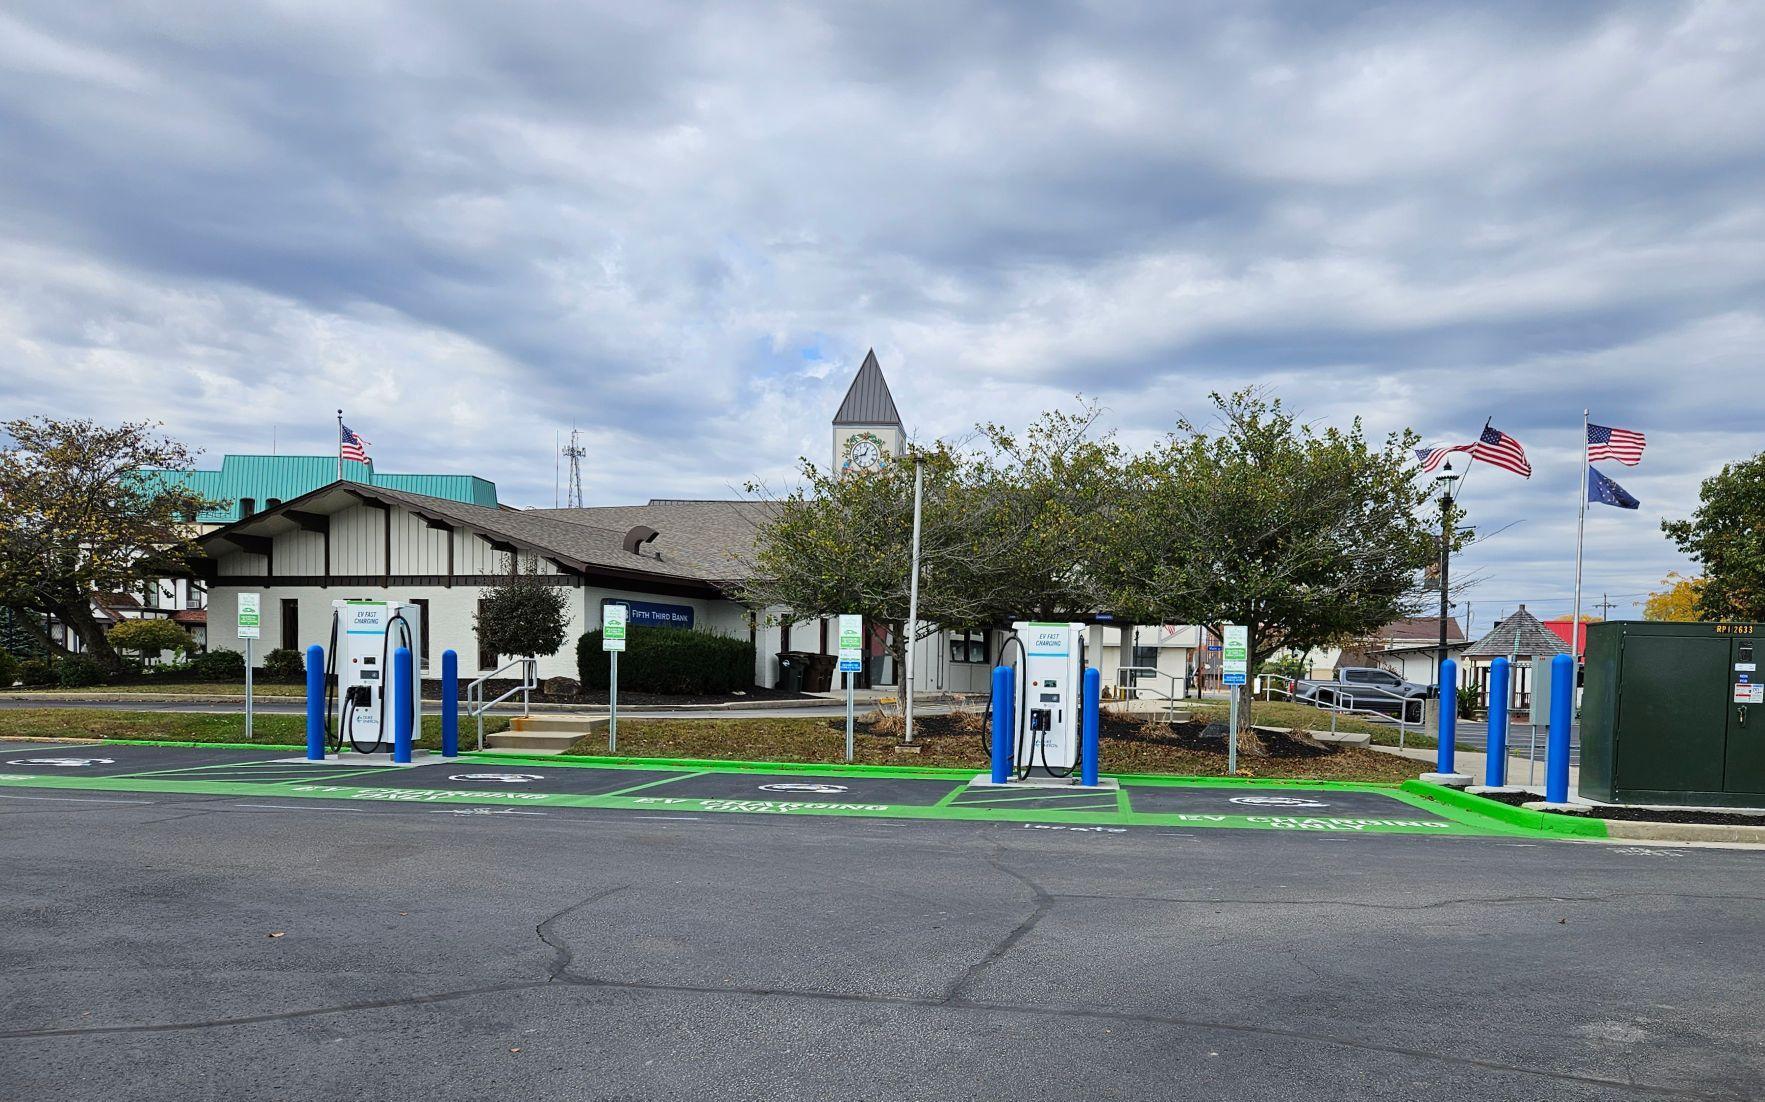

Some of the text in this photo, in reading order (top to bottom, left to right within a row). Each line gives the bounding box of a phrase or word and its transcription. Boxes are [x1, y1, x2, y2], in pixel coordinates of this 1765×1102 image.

[632, 609, 650, 619] FIFTH
[651, 611, 671, 621] THIRD
[671, 613, 688, 622] BANK
[354, 617, 379, 625] CHARGING
[1733, 625, 1753, 634] 2633
[699, 800, 889, 811] CHARGING
[704, 805, 801, 813] ONLY
[1246, 816, 1450, 828] CHARGING
[1270, 822, 1366, 830] ONLY
